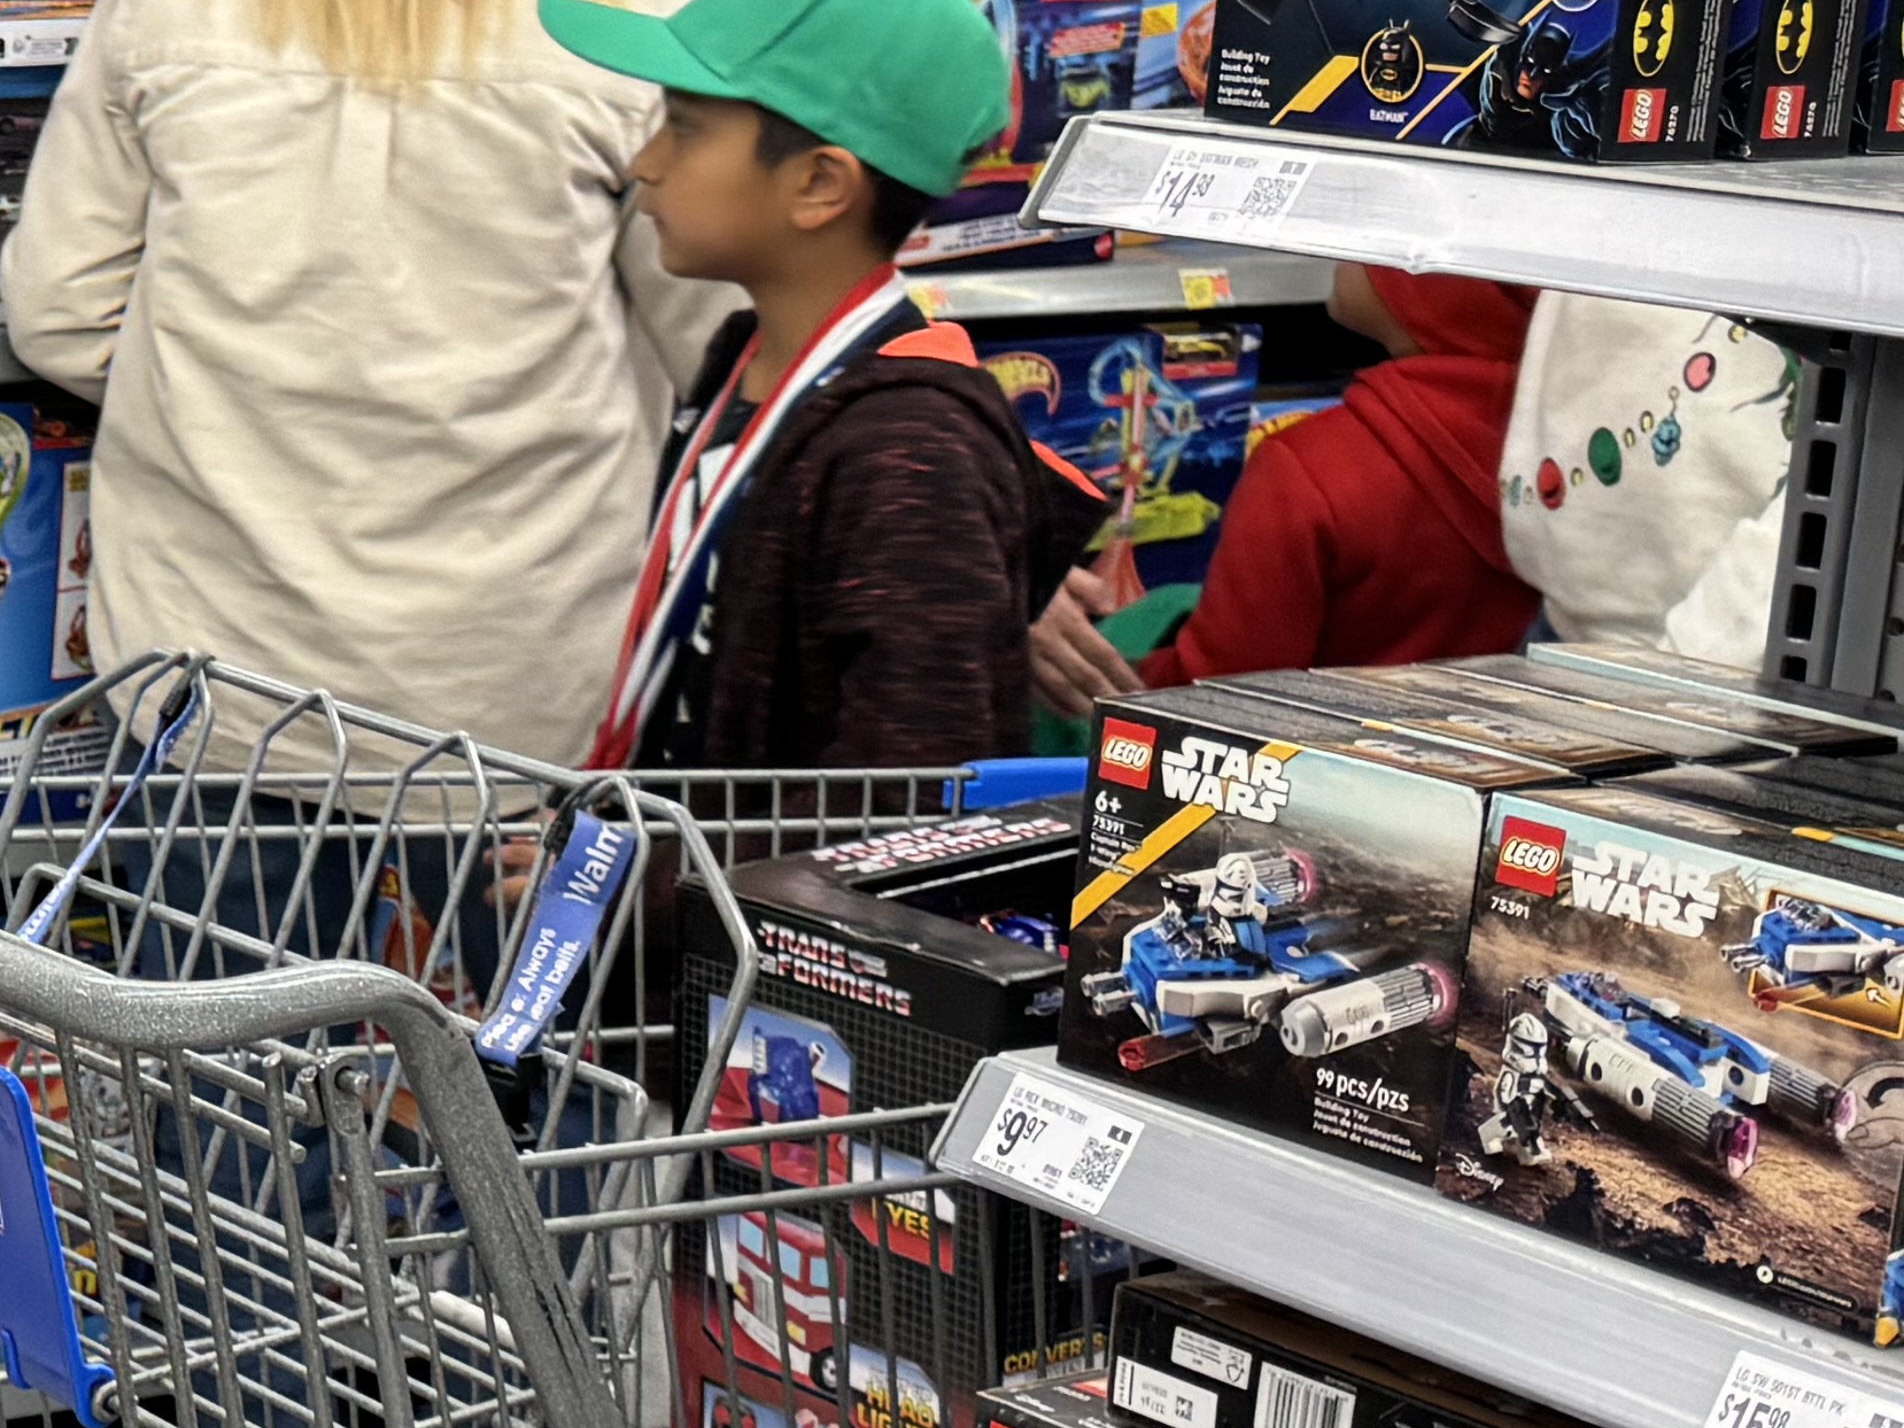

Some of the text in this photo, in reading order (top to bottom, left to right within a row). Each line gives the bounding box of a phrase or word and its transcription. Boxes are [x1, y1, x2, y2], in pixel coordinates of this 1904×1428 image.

[1629, 93, 1654, 139] LEGO
[1772, 89, 1796, 137] LEGO
[1103, 736, 1291, 794] LEGO STAR
[1095, 790, 1122, 814] 6+
[1161, 762, 1288, 823] WARS
[1092, 815, 1125, 835] 75391
[1502, 839, 1721, 908] LEGO STAR
[1490, 896, 1530, 920] 75391
[1571, 868, 1717, 938] WARS
[517, 927, 557, 993] Always
[776, 952, 912, 1017] FORMERS
[1316, 1068, 1410, 1113] 99 pcs/pzs
[871, 1196, 932, 1240] YES
[865, 1384, 935, 1426] HAD
